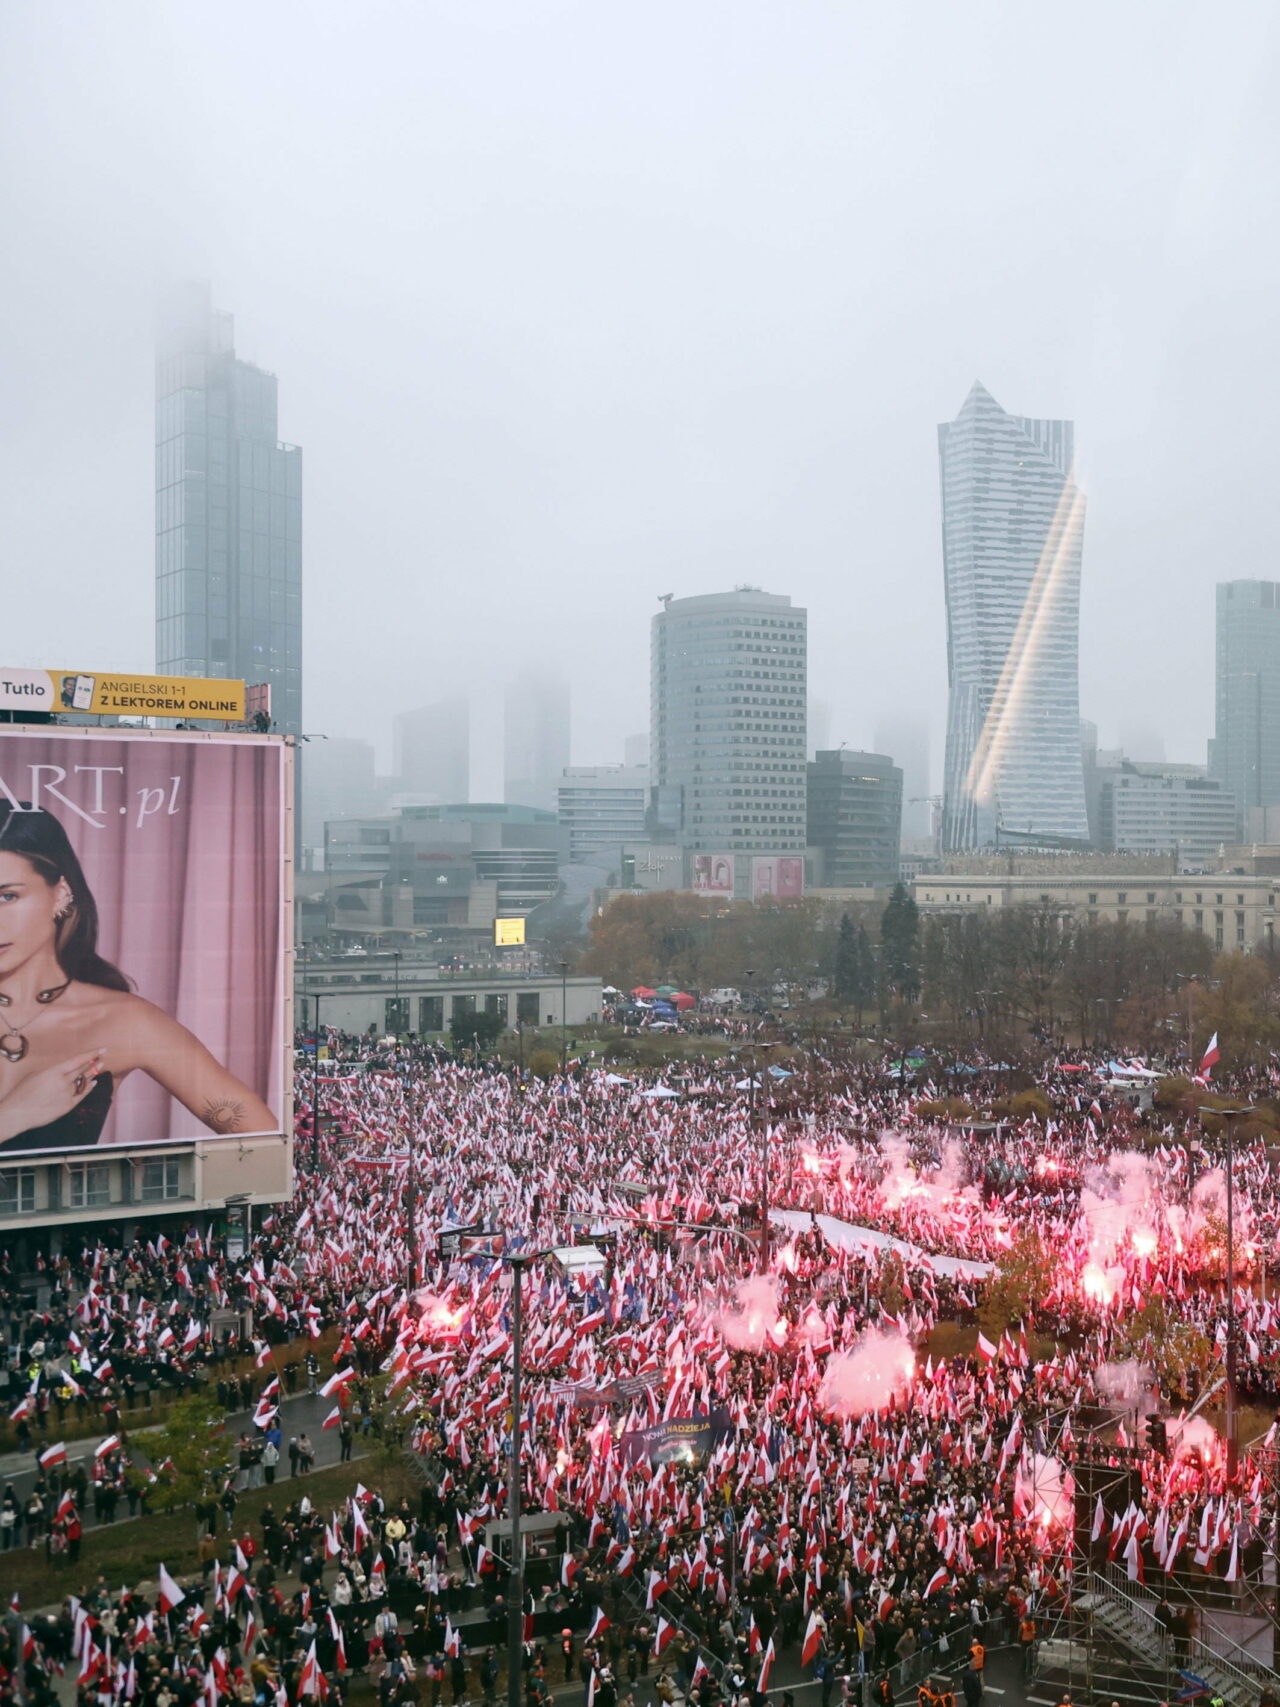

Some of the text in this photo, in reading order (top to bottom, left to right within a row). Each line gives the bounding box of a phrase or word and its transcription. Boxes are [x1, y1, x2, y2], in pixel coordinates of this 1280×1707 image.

[2, 681, 45, 696] Tutlo
[100, 681, 186, 696] ANGIELSKI 1-1
[100, 695, 238, 712] Z LEKTOREM ONLINE
[666, 1422, 711, 1434] NADZIEJA
